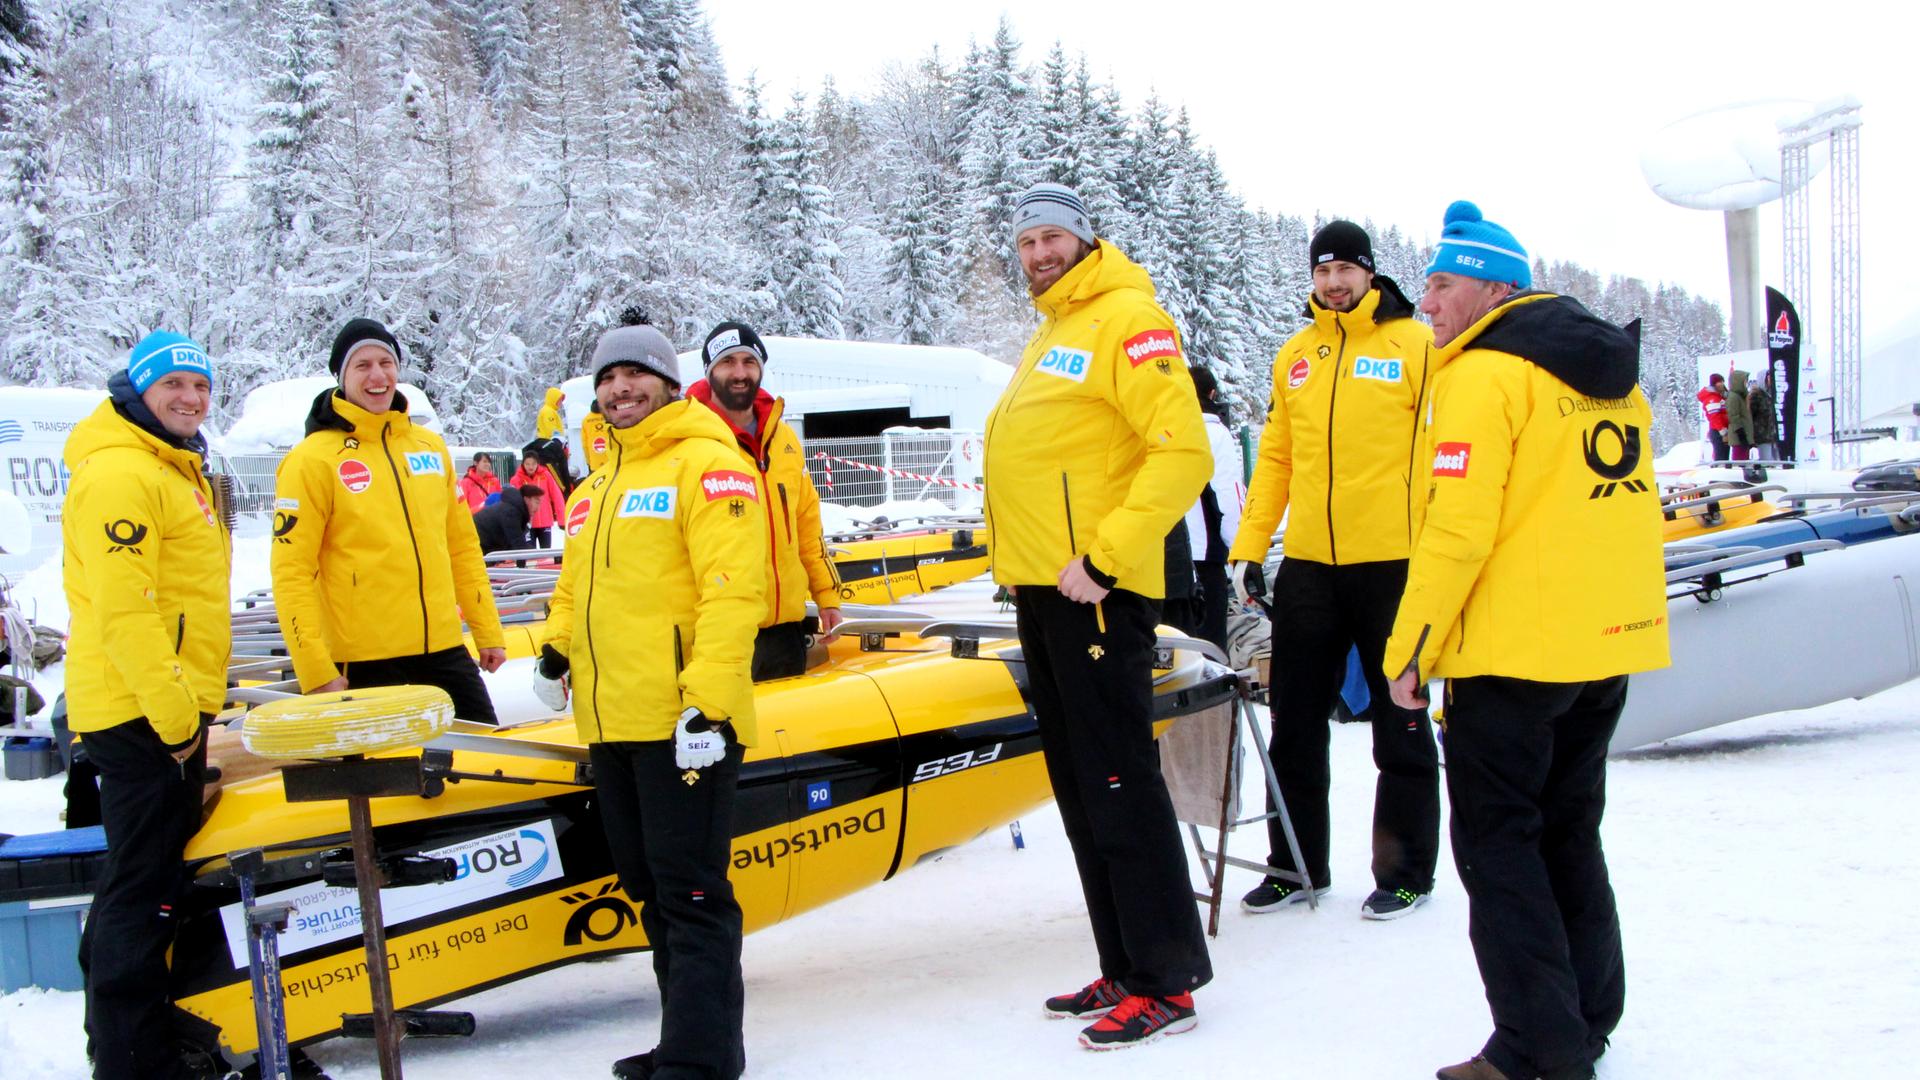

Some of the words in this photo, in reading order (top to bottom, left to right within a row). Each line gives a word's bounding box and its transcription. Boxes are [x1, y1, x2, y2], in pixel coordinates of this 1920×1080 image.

[1456, 254, 1486, 269] SEIZ
[176, 351, 204, 365] DKB
[1041, 349, 1085, 375] DKB
[1355, 358, 1401, 379] DKB
[625, 491, 670, 512] DKB
[856, 582, 875, 590] Post
[733, 807, 885, 869] Deutsche
[311, 926, 329, 936] THE
[493, 914, 529, 936] Der
[447, 926, 487, 949] Bob
[408, 938, 440, 961] für
